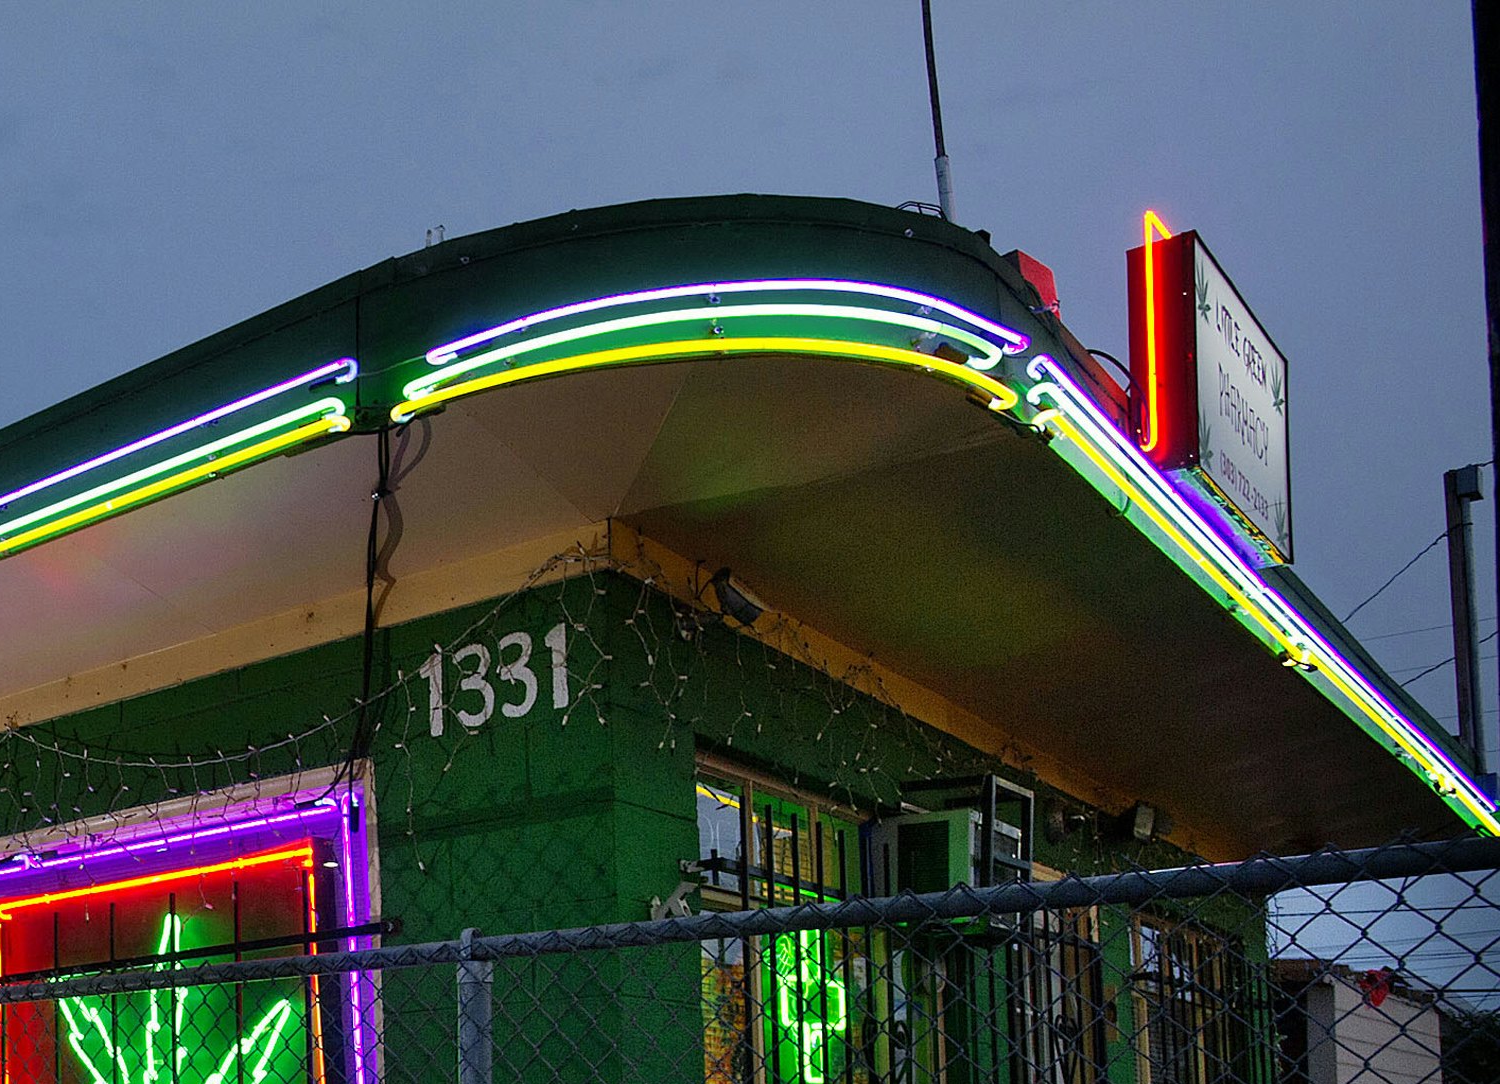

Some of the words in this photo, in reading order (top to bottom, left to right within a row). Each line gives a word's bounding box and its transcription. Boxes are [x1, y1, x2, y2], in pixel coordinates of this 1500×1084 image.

[1216, 294, 1240, 357] LITTLE
[1242, 336, 1267, 392] GREEN
[1218, 362, 1269, 467] PHARMACY
[419, 622, 570, 737] 1331
